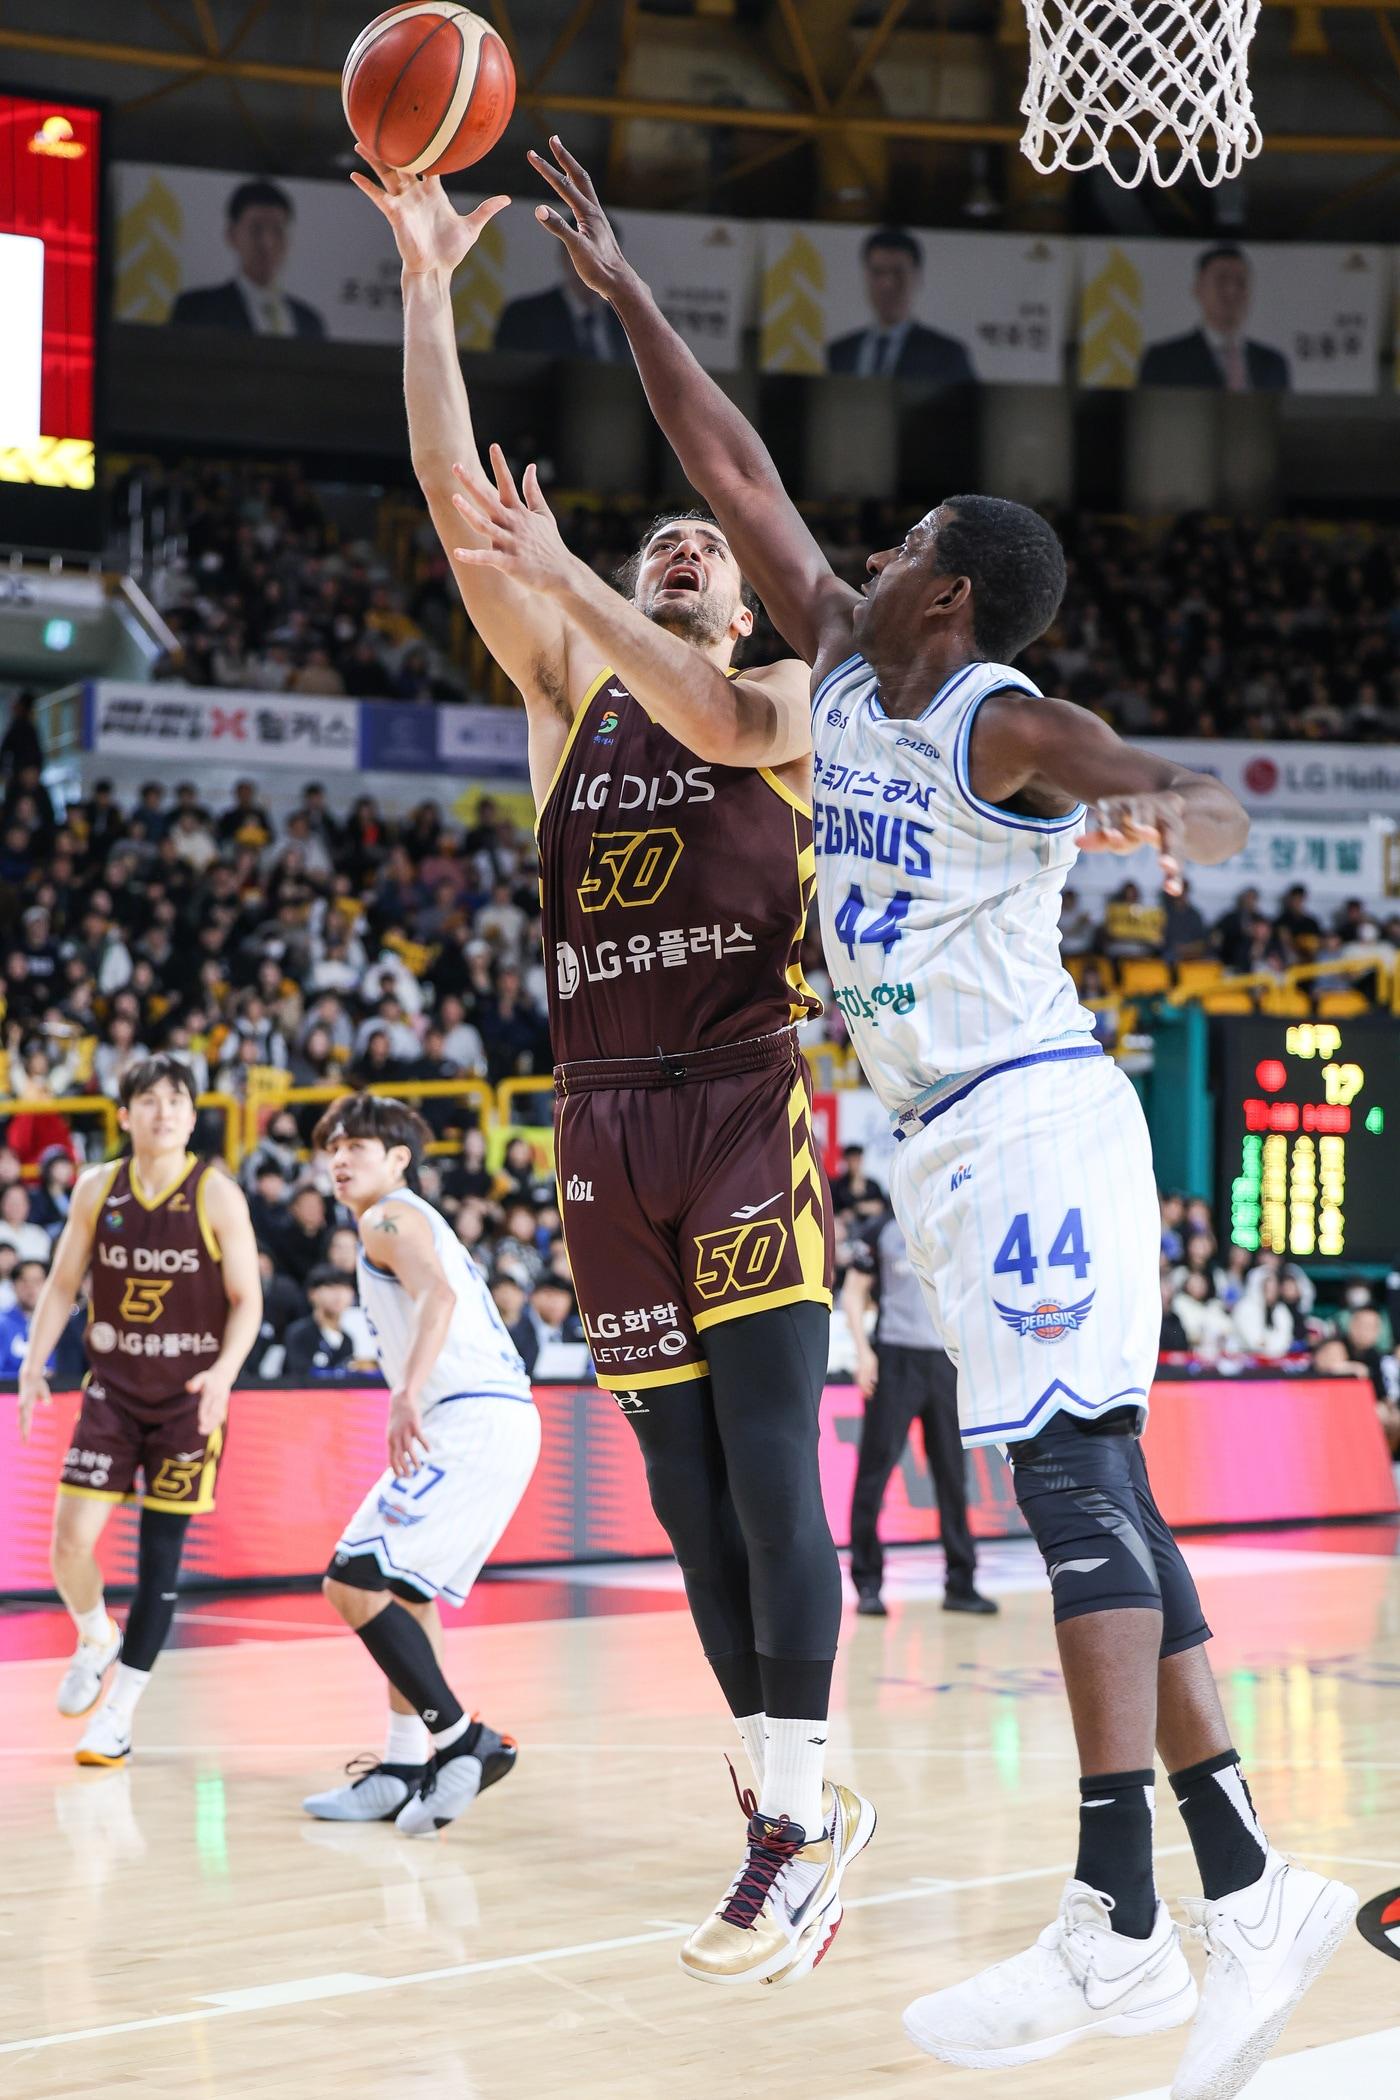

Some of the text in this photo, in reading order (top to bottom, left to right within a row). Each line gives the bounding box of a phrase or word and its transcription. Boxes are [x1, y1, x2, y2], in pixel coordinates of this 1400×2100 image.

[895, 737, 941, 760] DAEGU
[571, 766, 716, 812] LG DIOS
[814, 801, 935, 879] EGASUS
[576, 827, 685, 914] 50
[834, 883, 912, 961] 44
[566, 1173, 595, 1202] KBL
[133, 1248, 200, 1273] DIOS
[693, 1217, 788, 1300] 50
[993, 1207, 1092, 1285] 44
[119, 1277, 174, 1324] 5
[1019, 1310, 1080, 1337] PEGASUS
[152, 1458, 203, 1500] 5
